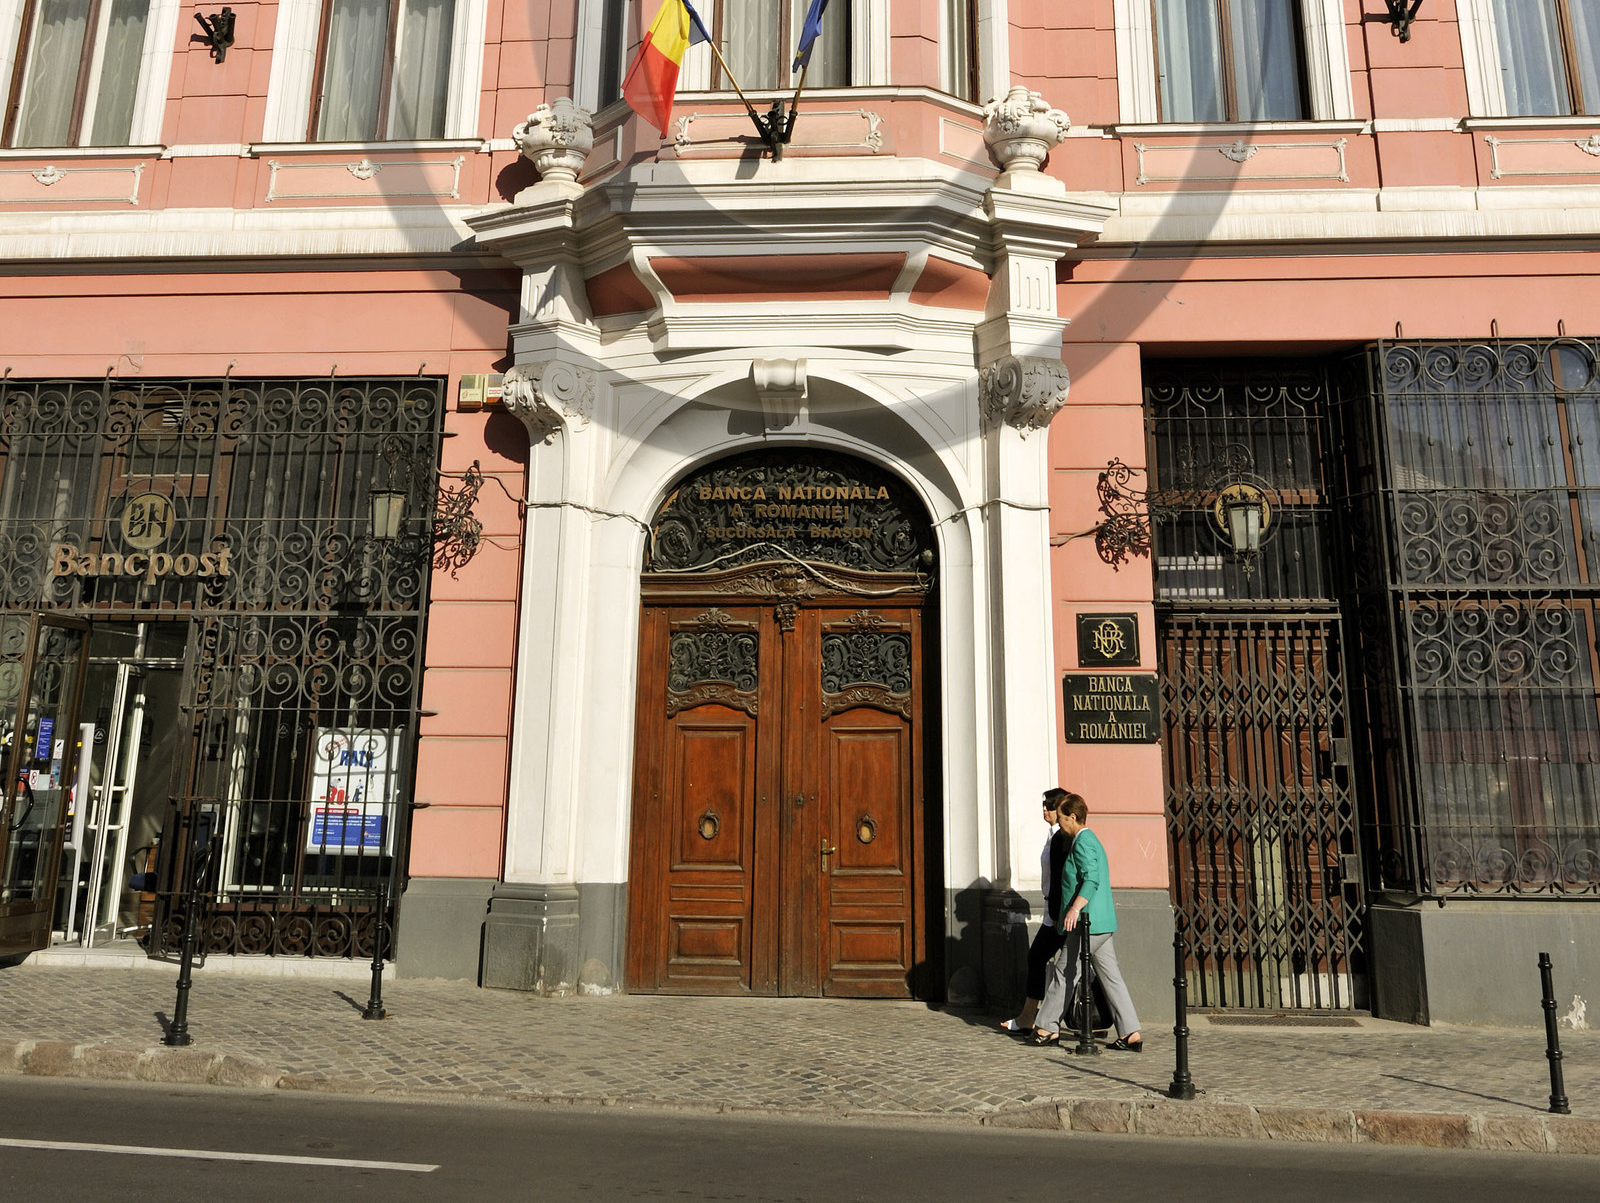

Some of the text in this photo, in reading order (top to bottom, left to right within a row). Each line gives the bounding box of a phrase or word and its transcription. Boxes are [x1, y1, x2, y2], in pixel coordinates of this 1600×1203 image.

[700, 486, 890, 501] BANCA NATIONALA
[730, 503, 849, 521] A ROMANIEI
[706, 527, 797, 539] SUCURSALA
[53, 543, 233, 586] Bancpost
[1087, 676, 1134, 693] BANCA
[1073, 695, 1151, 711] NATIONALA
[1107, 711, 1117, 723] A
